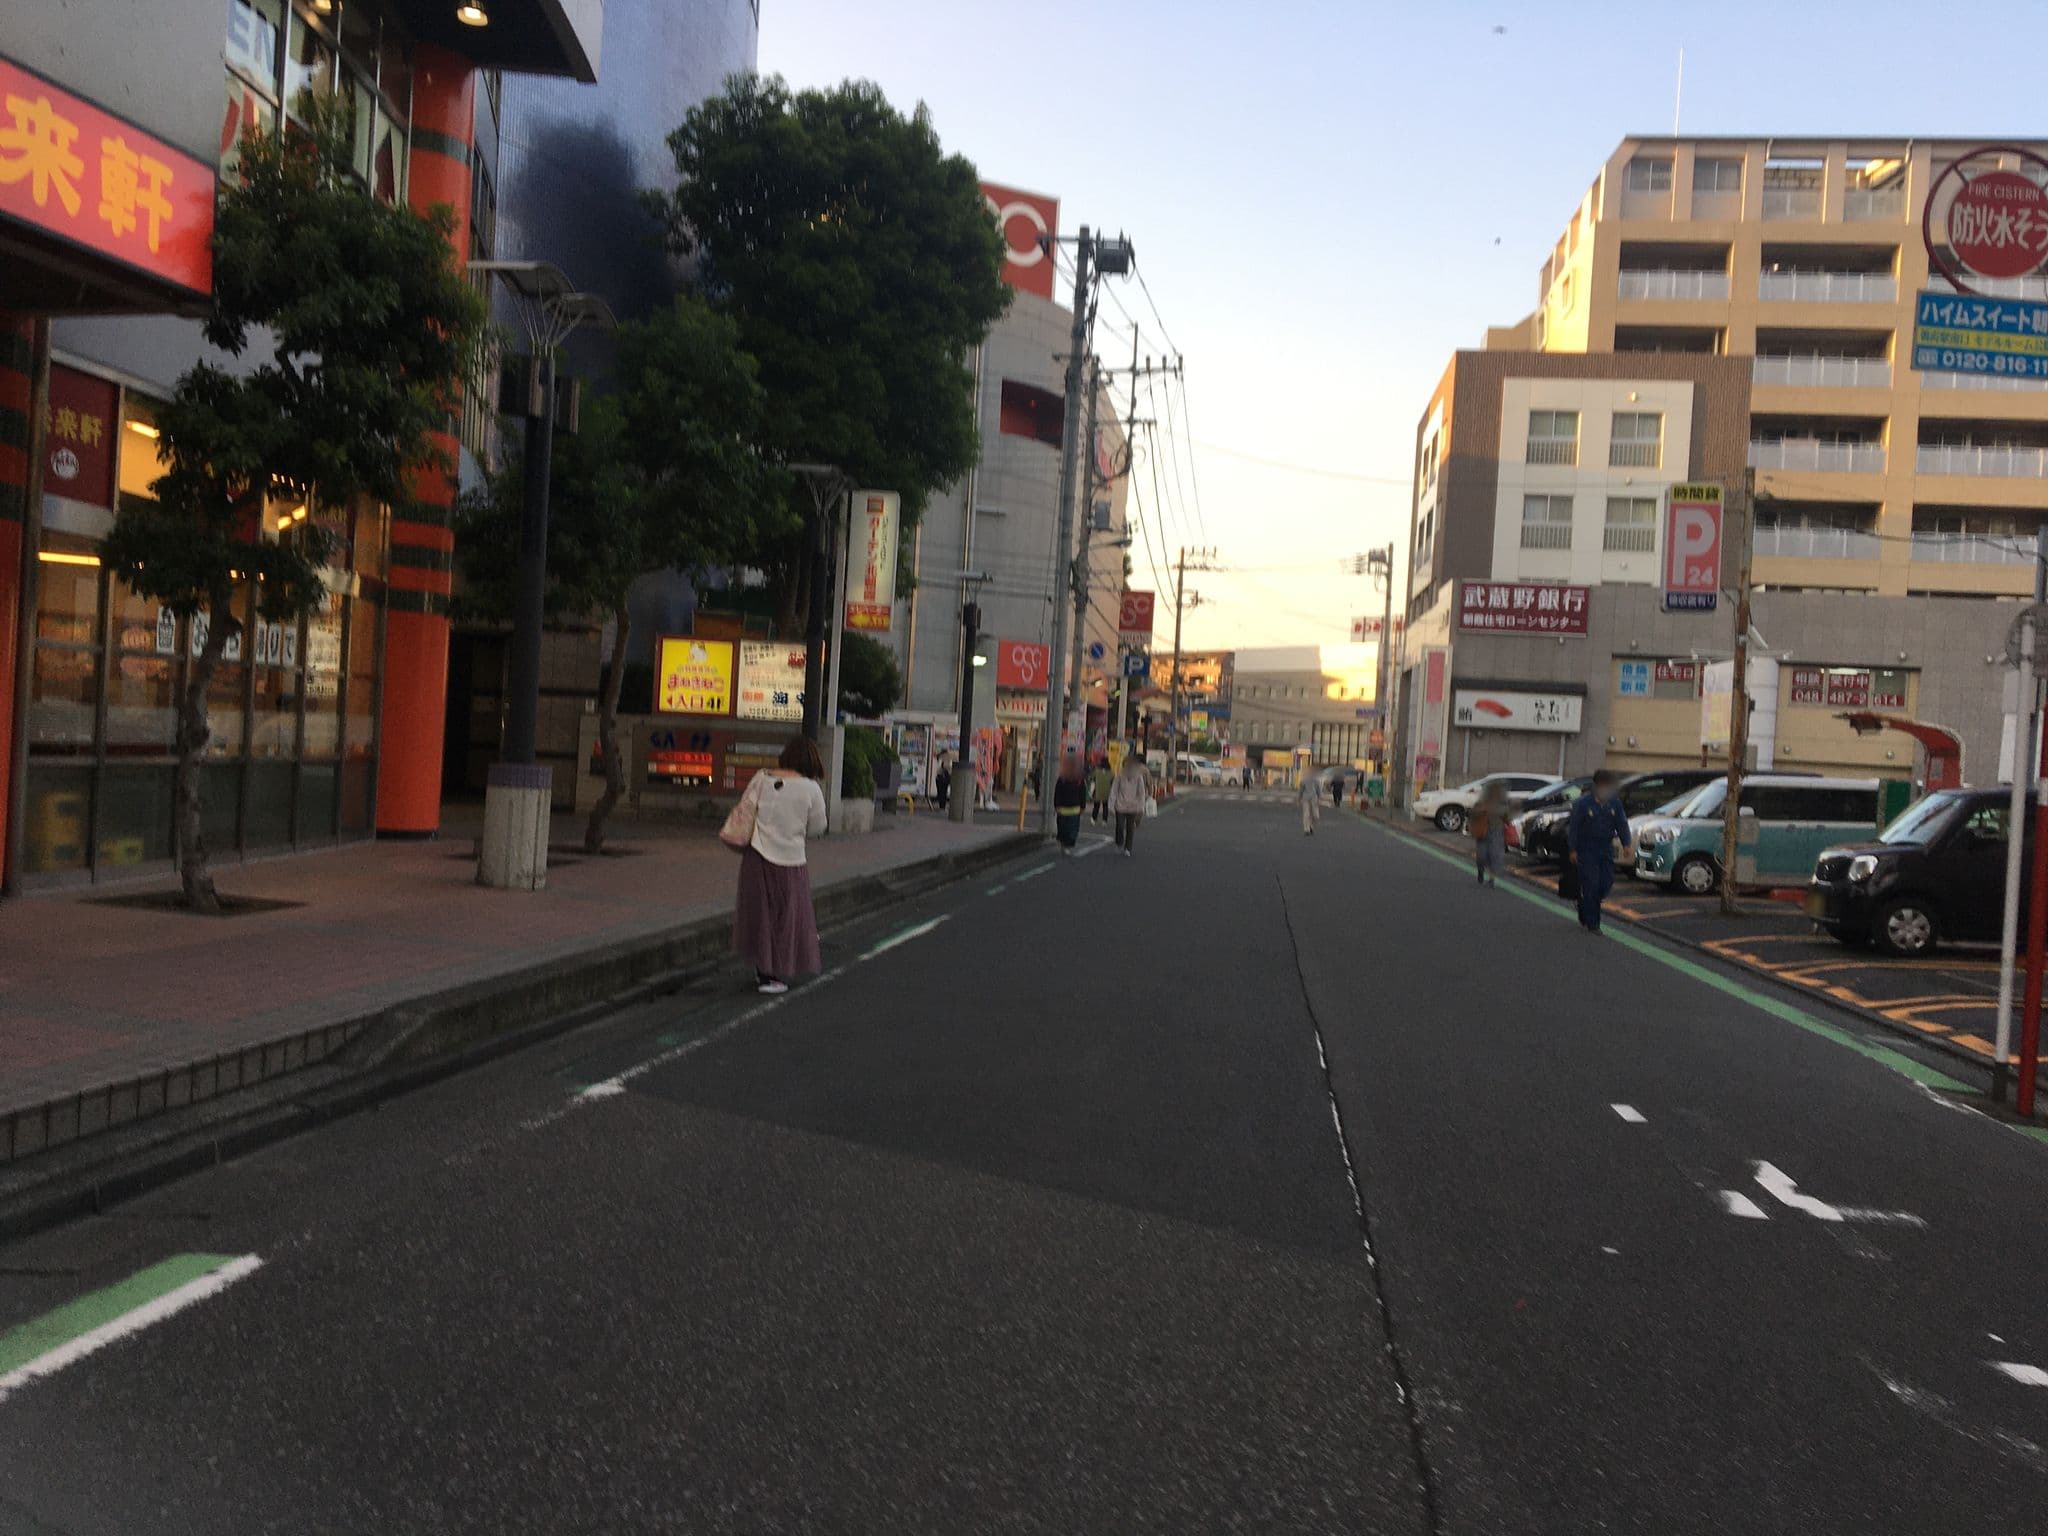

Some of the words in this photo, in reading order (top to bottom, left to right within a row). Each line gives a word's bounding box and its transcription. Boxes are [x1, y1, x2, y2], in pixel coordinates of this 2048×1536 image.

[1968, 183, 1991, 197] FIRE
[1952, 201, 2048, 250] 防火水そう
[1671, 508, 1716, 585] P
[1688, 565, 1714, 585] 24
[1464, 585, 1586, 613] 武蔵野銀行
